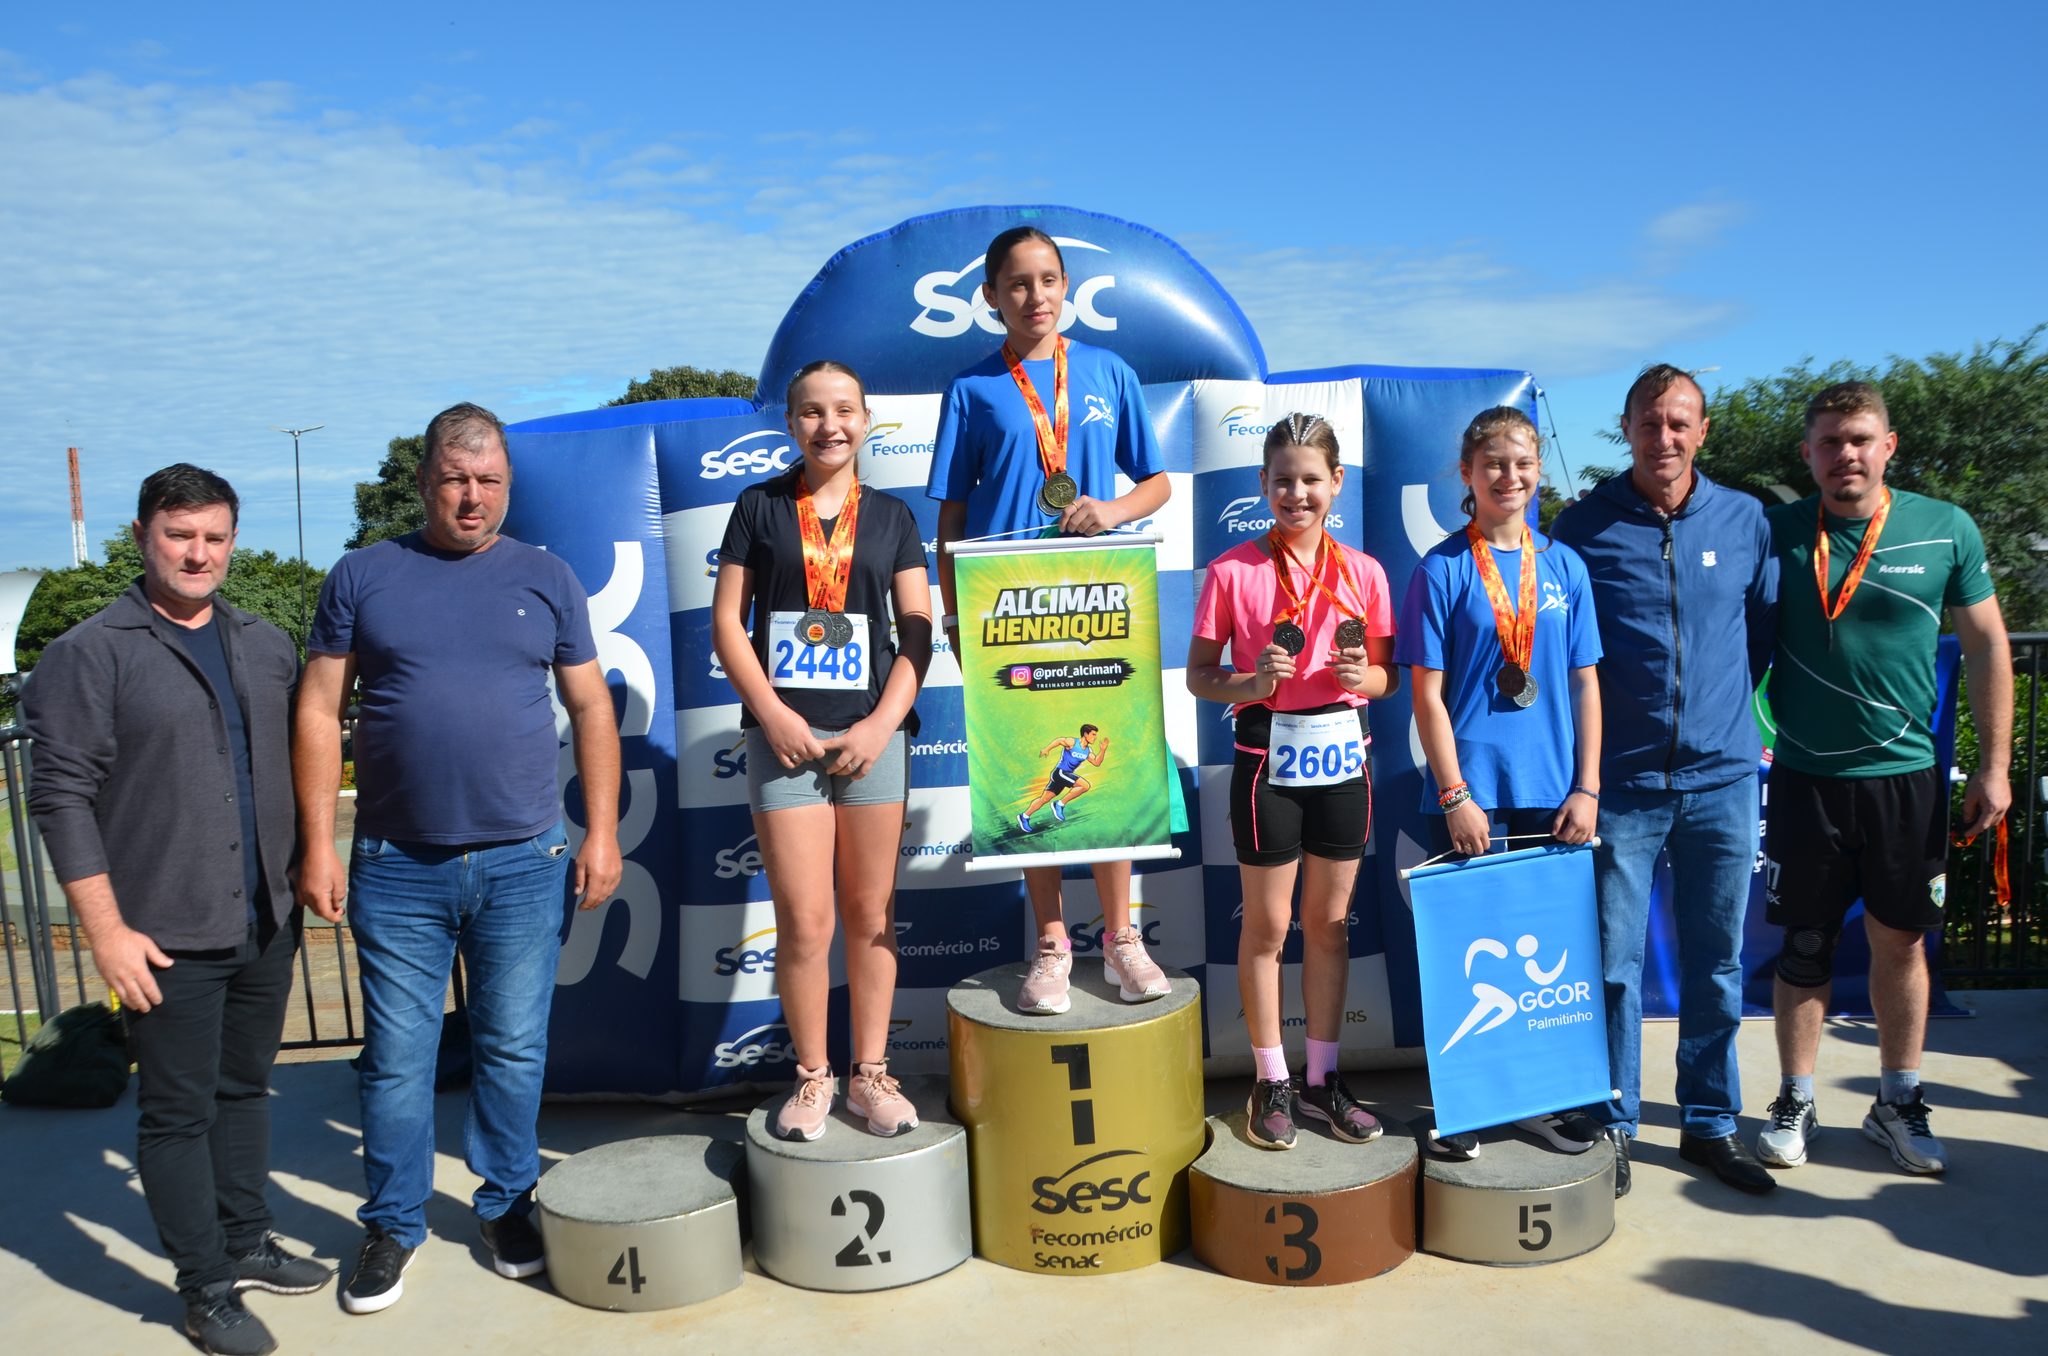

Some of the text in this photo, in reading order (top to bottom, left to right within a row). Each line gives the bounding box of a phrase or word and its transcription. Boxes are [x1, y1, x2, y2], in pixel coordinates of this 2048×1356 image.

[995, 585, 1126, 617] ALCIMAR
[986, 612, 1126, 643] HENRIQUE
[774, 640, 862, 681] 2448
[1033, 663, 1122, 680] @prof_alcimarh
[1275, 741, 1363, 779] 2605
[897, 936, 1000, 957] comércio RS
[1519, 981, 1591, 1013] GCOR
[1346, 1009, 1367, 1023] RS
[1527, 1010, 1593, 1031] Palmitinho
[831, 1190, 891, 1267] 2
[1030, 1222, 1152, 1247] Fecomércio
[1264, 1202, 1322, 1281] 3
[1518, 1203, 1552, 1251] 5
[607, 1247, 646, 1294] 4
[1034, 1252, 1100, 1269] Senac
